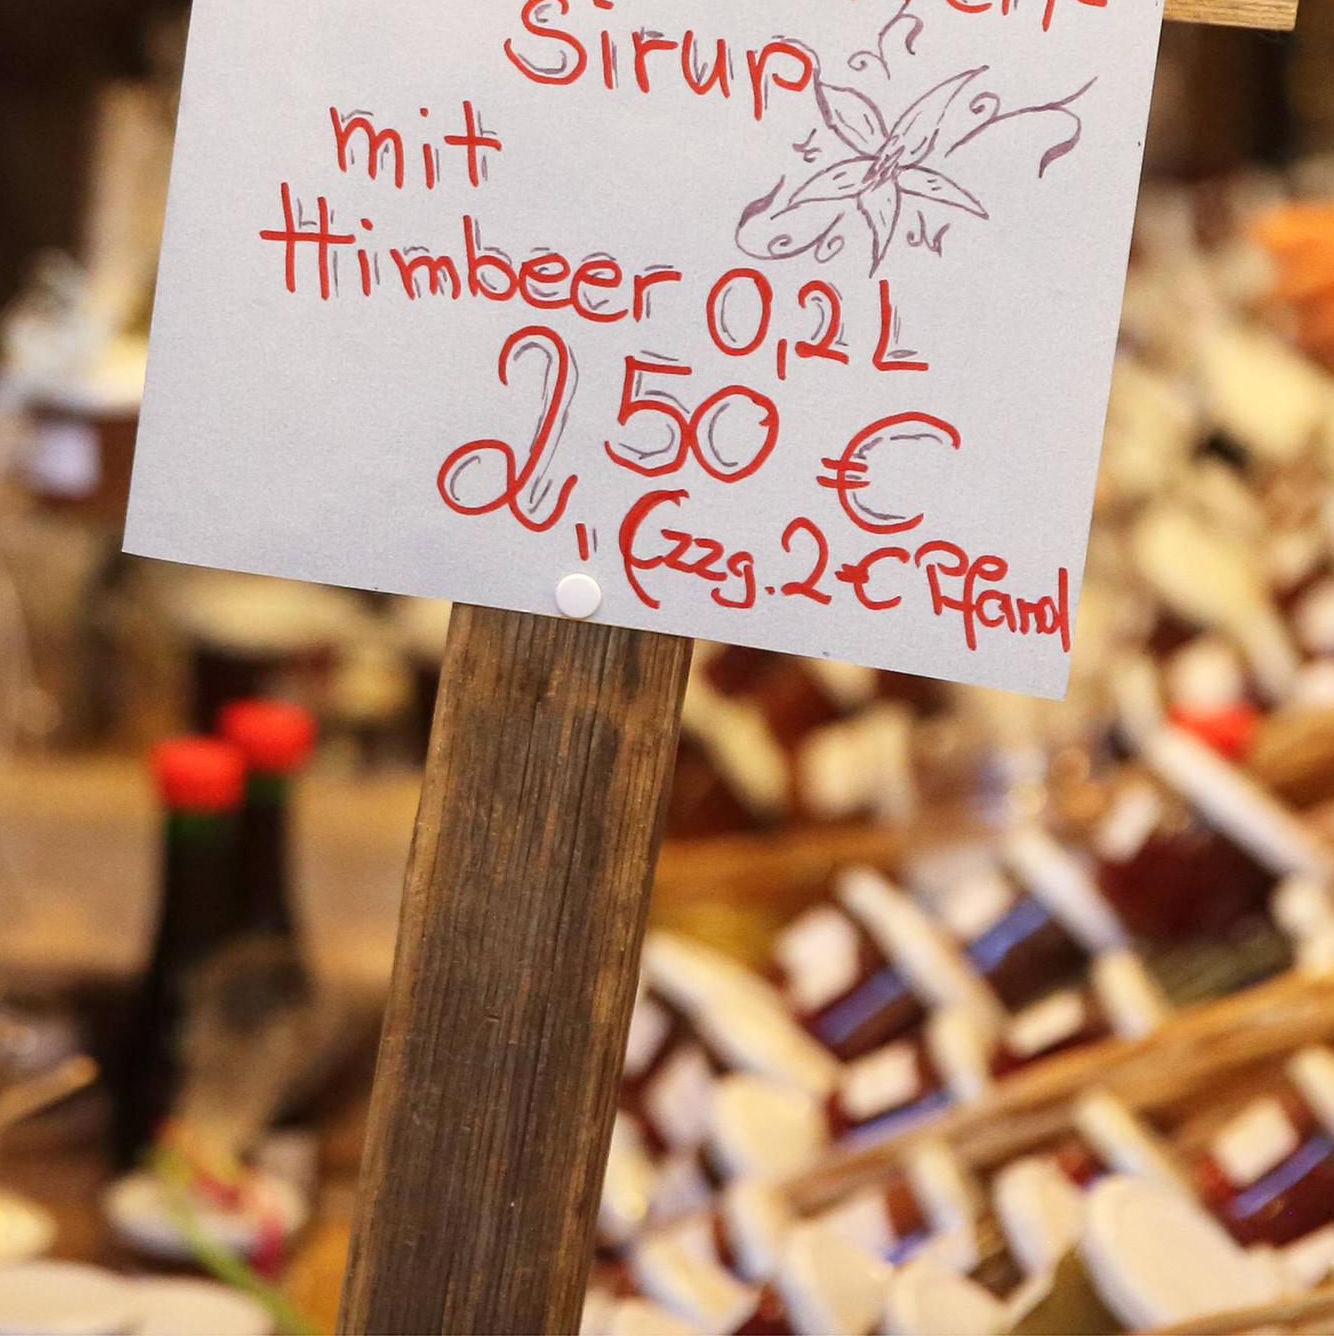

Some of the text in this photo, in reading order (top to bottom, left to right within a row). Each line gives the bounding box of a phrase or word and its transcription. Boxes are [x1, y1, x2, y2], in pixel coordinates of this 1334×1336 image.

[330, 98, 503, 190] mit
[260, 182, 681, 324] Himbeer
[816, 411, 962, 535] €
[917, 540, 1072, 653] Pfand
